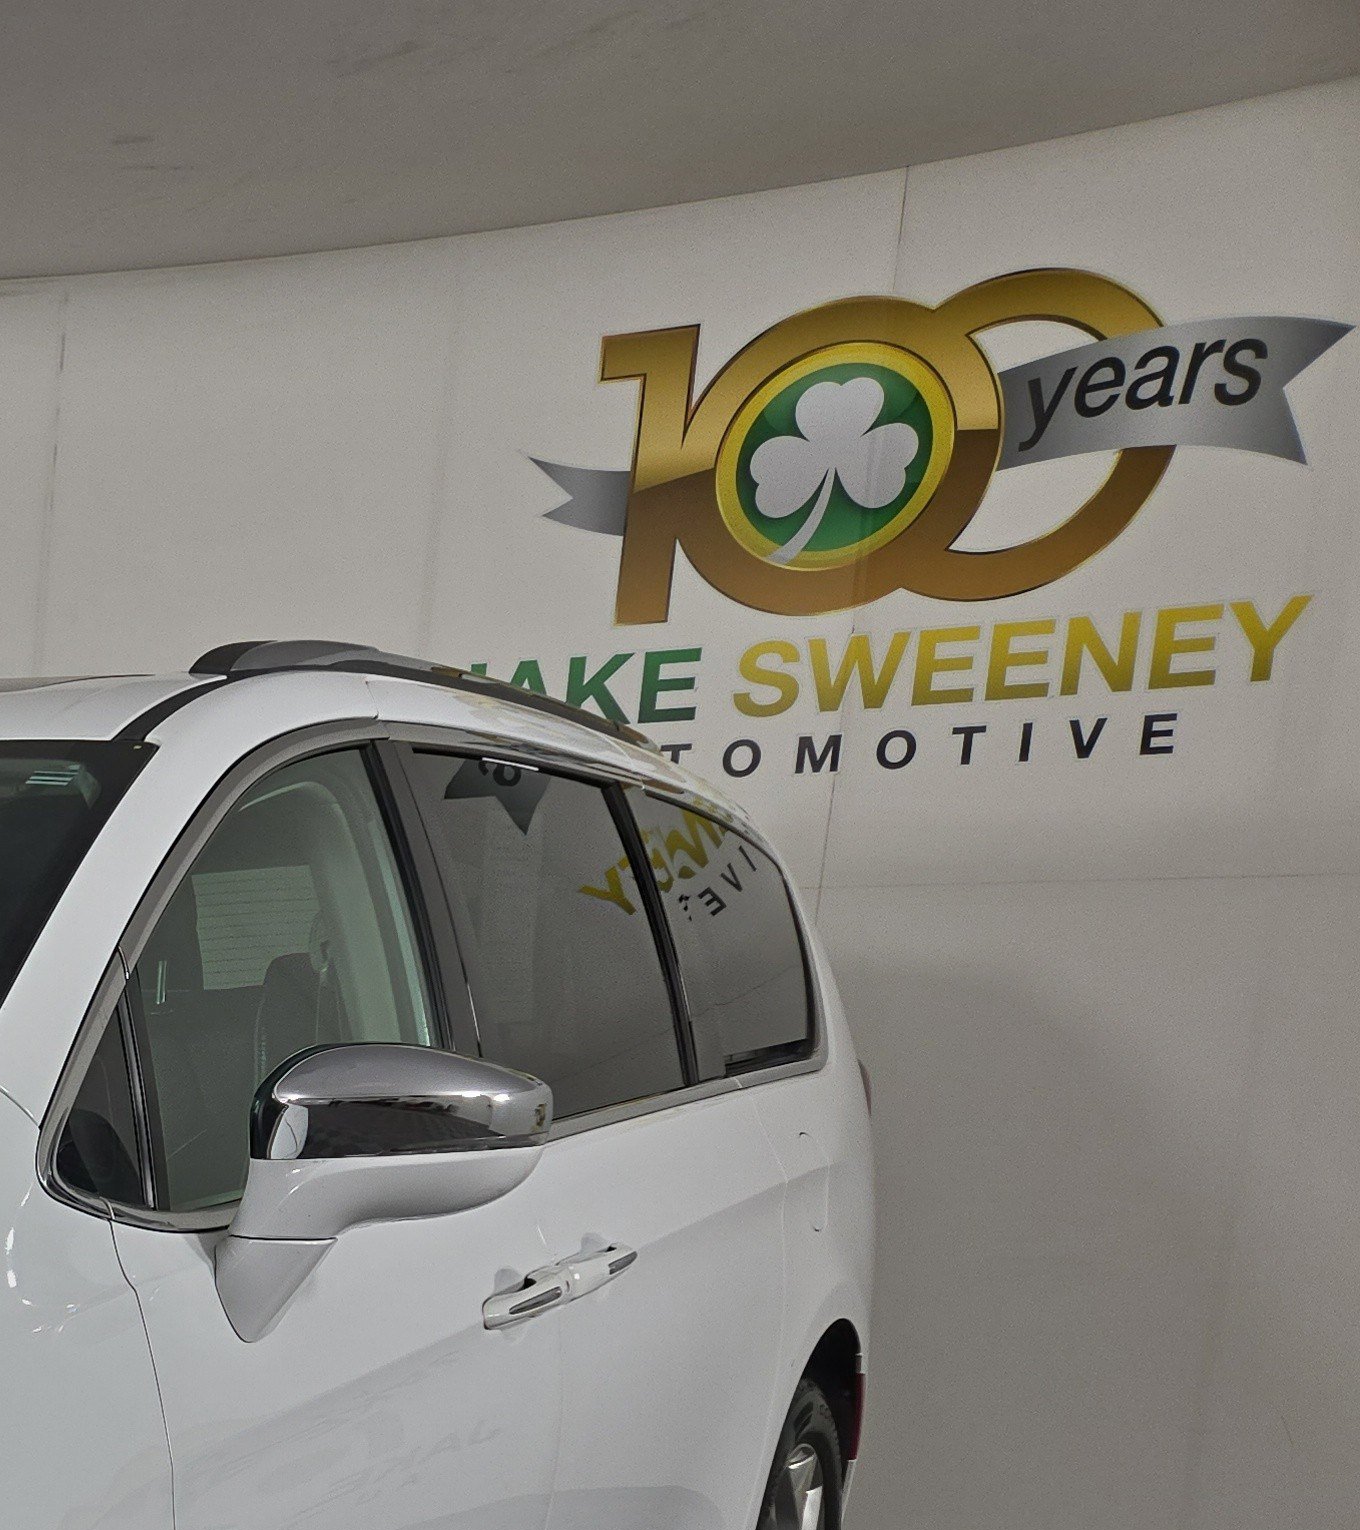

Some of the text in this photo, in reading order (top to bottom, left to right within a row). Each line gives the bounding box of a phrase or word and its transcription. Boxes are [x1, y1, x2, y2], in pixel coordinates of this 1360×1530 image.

[598, 267, 1178, 626] 100
[1017, 336, 1269, 452] years
[470, 595, 1313, 724] AKE SWEENEY
[661, 713, 1177, 778] TOMOTIVE
